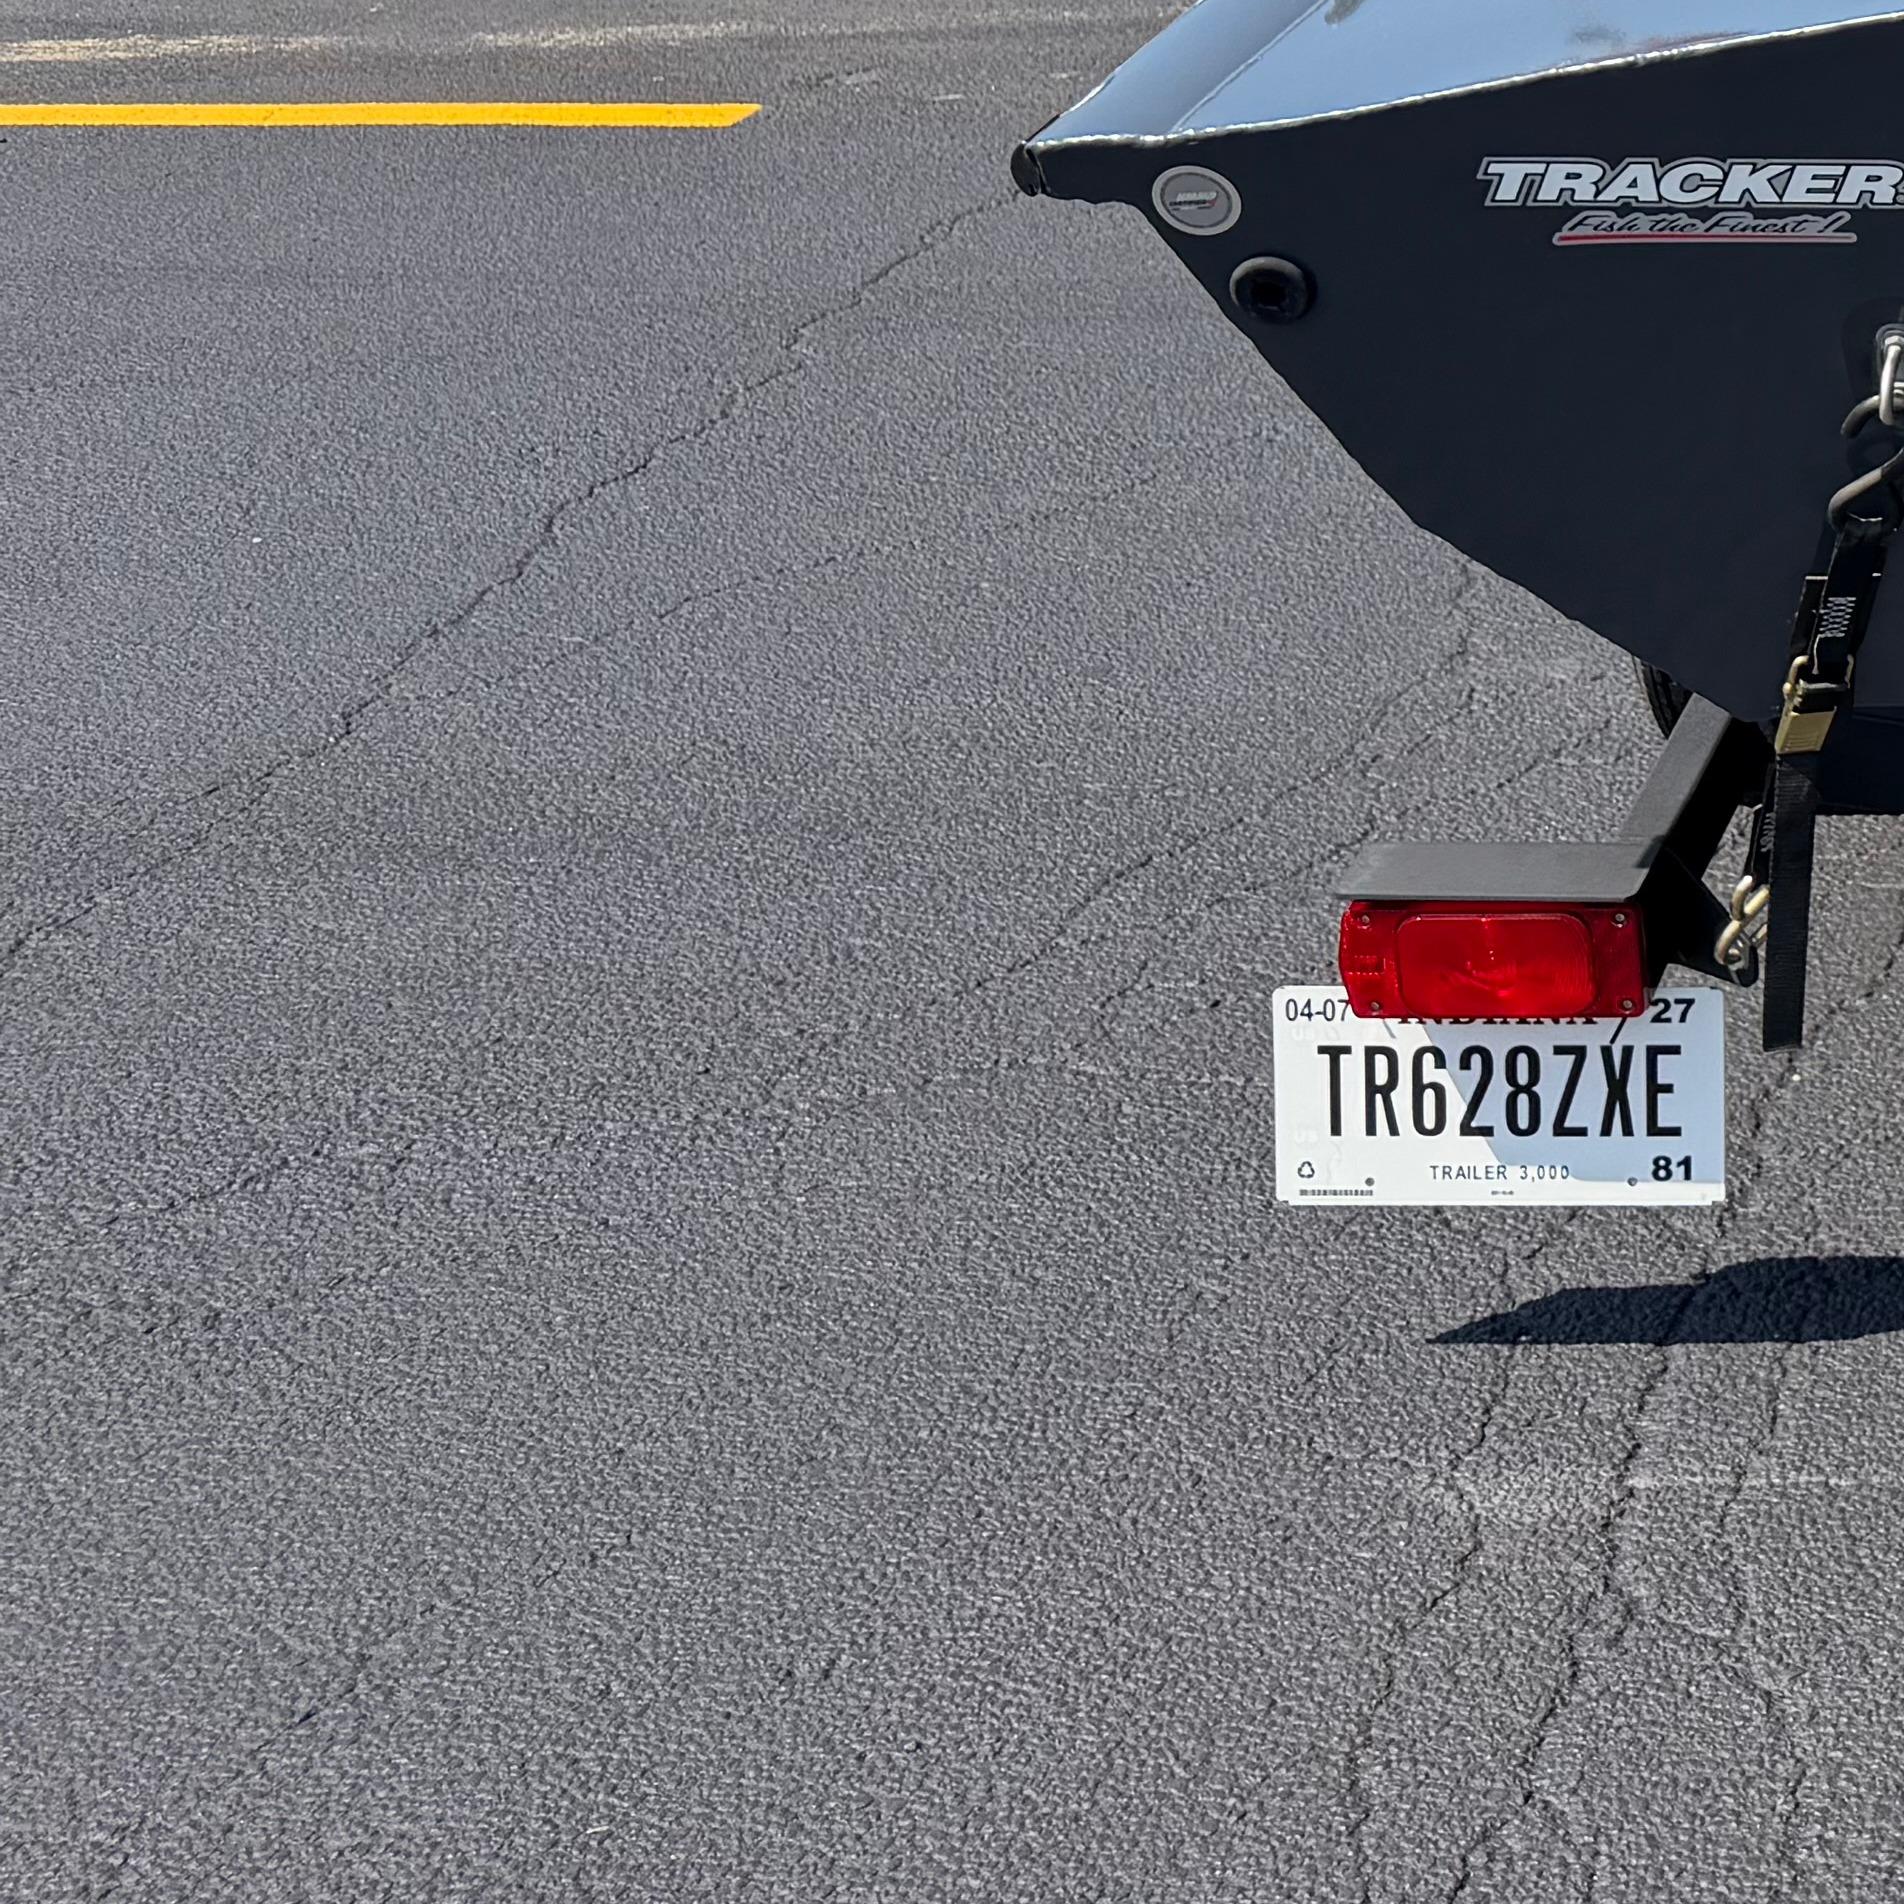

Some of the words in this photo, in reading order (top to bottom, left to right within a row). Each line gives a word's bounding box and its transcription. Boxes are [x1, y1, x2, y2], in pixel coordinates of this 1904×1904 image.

[1485, 162, 1904, 205] TRACKER
[1567, 210, 1641, 233] Fish
[1647, 211, 1697, 233] the
[1285, 998, 1349, 1023] 04-07
[1649, 997, 1696, 1024] 27
[1316, 1044, 1683, 1138] TR628ZXE
[1429, 1164, 1508, 1181] TRAILER
[1519, 1164, 1571, 1183] 3,000
[1650, 1155, 1694, 1182] 81
